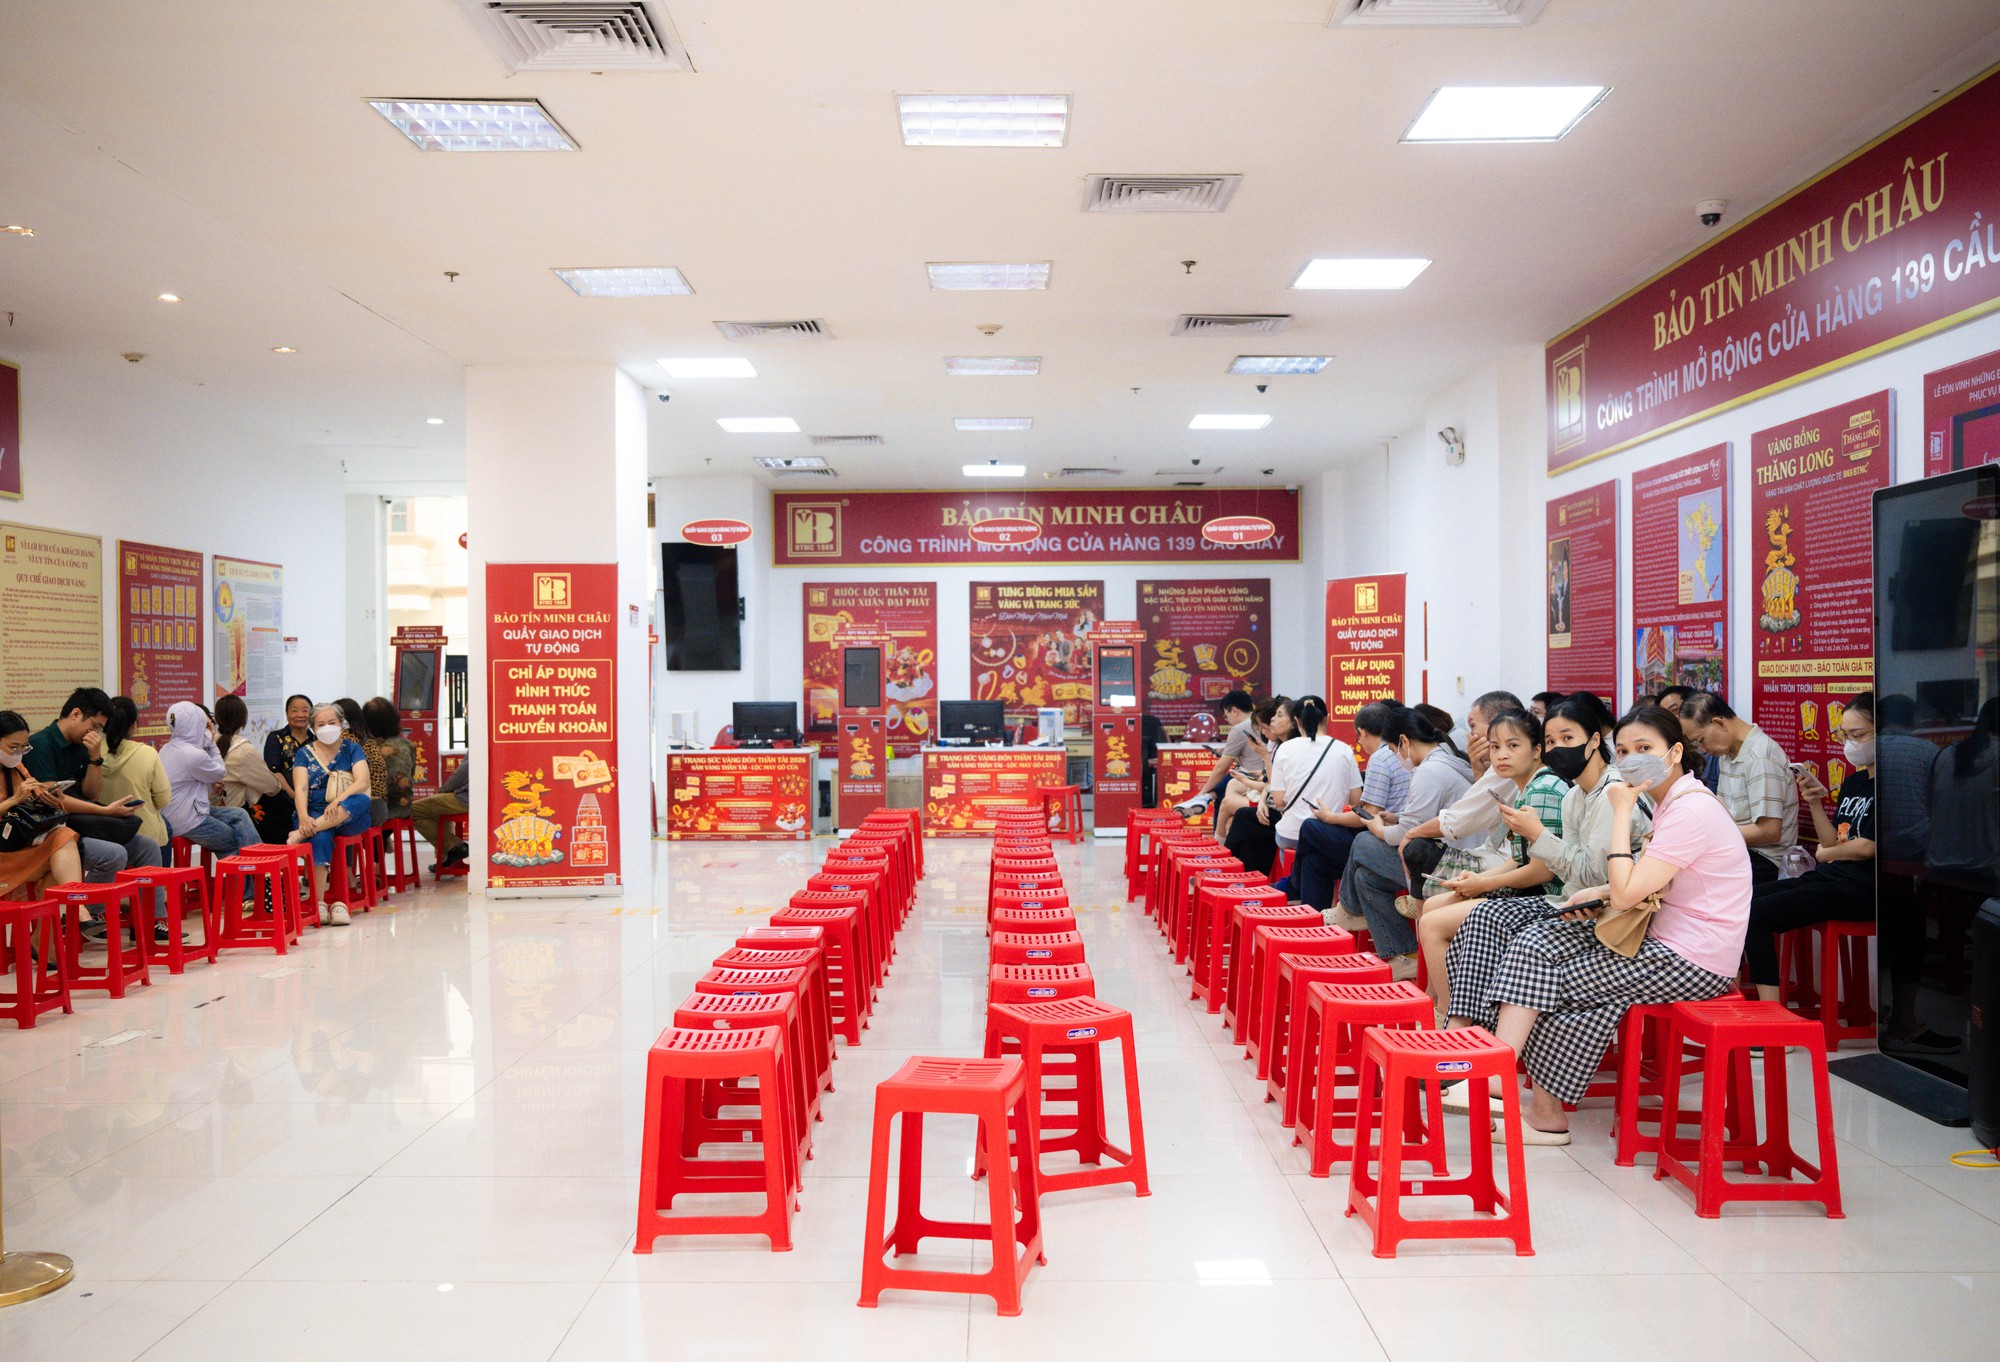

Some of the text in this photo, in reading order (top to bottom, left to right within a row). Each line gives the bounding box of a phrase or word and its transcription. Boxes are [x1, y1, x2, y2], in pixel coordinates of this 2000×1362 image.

[1653, 152, 1948, 351] BẢO TÍN MINH CHÂU
[1597, 391, 1633, 430] CÔNG
[1636, 369, 1679, 413] TRÌNH
[1683, 345, 1707, 394] MỞ
[1712, 331, 1762, 382] RỘNG
[1768, 303, 1810, 357] CỬA
[1816, 276, 1882, 337] HÀNG
[1892, 253, 1935, 304] 139
[1768, 426, 1820, 456] VÀNG RỒNG
[1757, 448, 1834, 486] THĂNG LONG
[1050, 506, 1125, 525] MINH
[1130, 500, 1203, 525] CHÂU
[711, 534, 723, 542] 03
[860, 535, 912, 553] CÔNG
[917, 534, 971, 552] TRÌNH
[1067, 531, 1104, 551] CỬA
[1110, 533, 1160, 551] HÀNG
[1166, 537, 1195, 550] 139
[999, 533, 1011, 541] 02
[1233, 532, 1243, 540] 01
[998, 584, 1097, 597] TƯNG BỪNG MUA SẮM
[998, 598, 1080, 608] VÀNG VÀ TRANG SỨC
[494, 611, 610, 623] BẢO TÍN MINH CHÂU
[1332, 614, 1402, 626] BẢO TÍN MINH CHÂU
[503, 625, 602, 642] QUẦY GIAO DỊCH
[1337, 627, 1398, 640] QUẦY GIAO DỊCH
[525, 642, 580, 655] TỰ ĐỘNG
[1350, 639, 1384, 651] TỰ ĐỘNG
[1340, 658, 1395, 672] CHỈ ÁP DỤNG
[1761, 664, 1775, 674] GIAO
[1776, 663, 1788, 675] DỊCH
[1790, 663, 1800, 675] MỌI
[1802, 663, 1812, 673] NƠI
[1817, 661, 1830, 673] BẢO
[1832, 661, 1849, 672] TOÀN
[508, 664, 597, 681] CHỈ ÁP DỤNG
[1344, 672, 1390, 686] HÌNH THỨC
[516, 682, 590, 697] HÌNH THỨC
[1341, 688, 1395, 700] THANH TOÁN
[1780, 682, 1795, 693] TRÒN
[1796, 683, 1812, 693] TRƠN
[509, 701, 597, 716] THANH TOÁN
[499, 718, 608, 734] CHUYỂN KHOẢN
[708, 756, 721, 764] SỨC
[742, 756, 756, 764] ĐÓN
